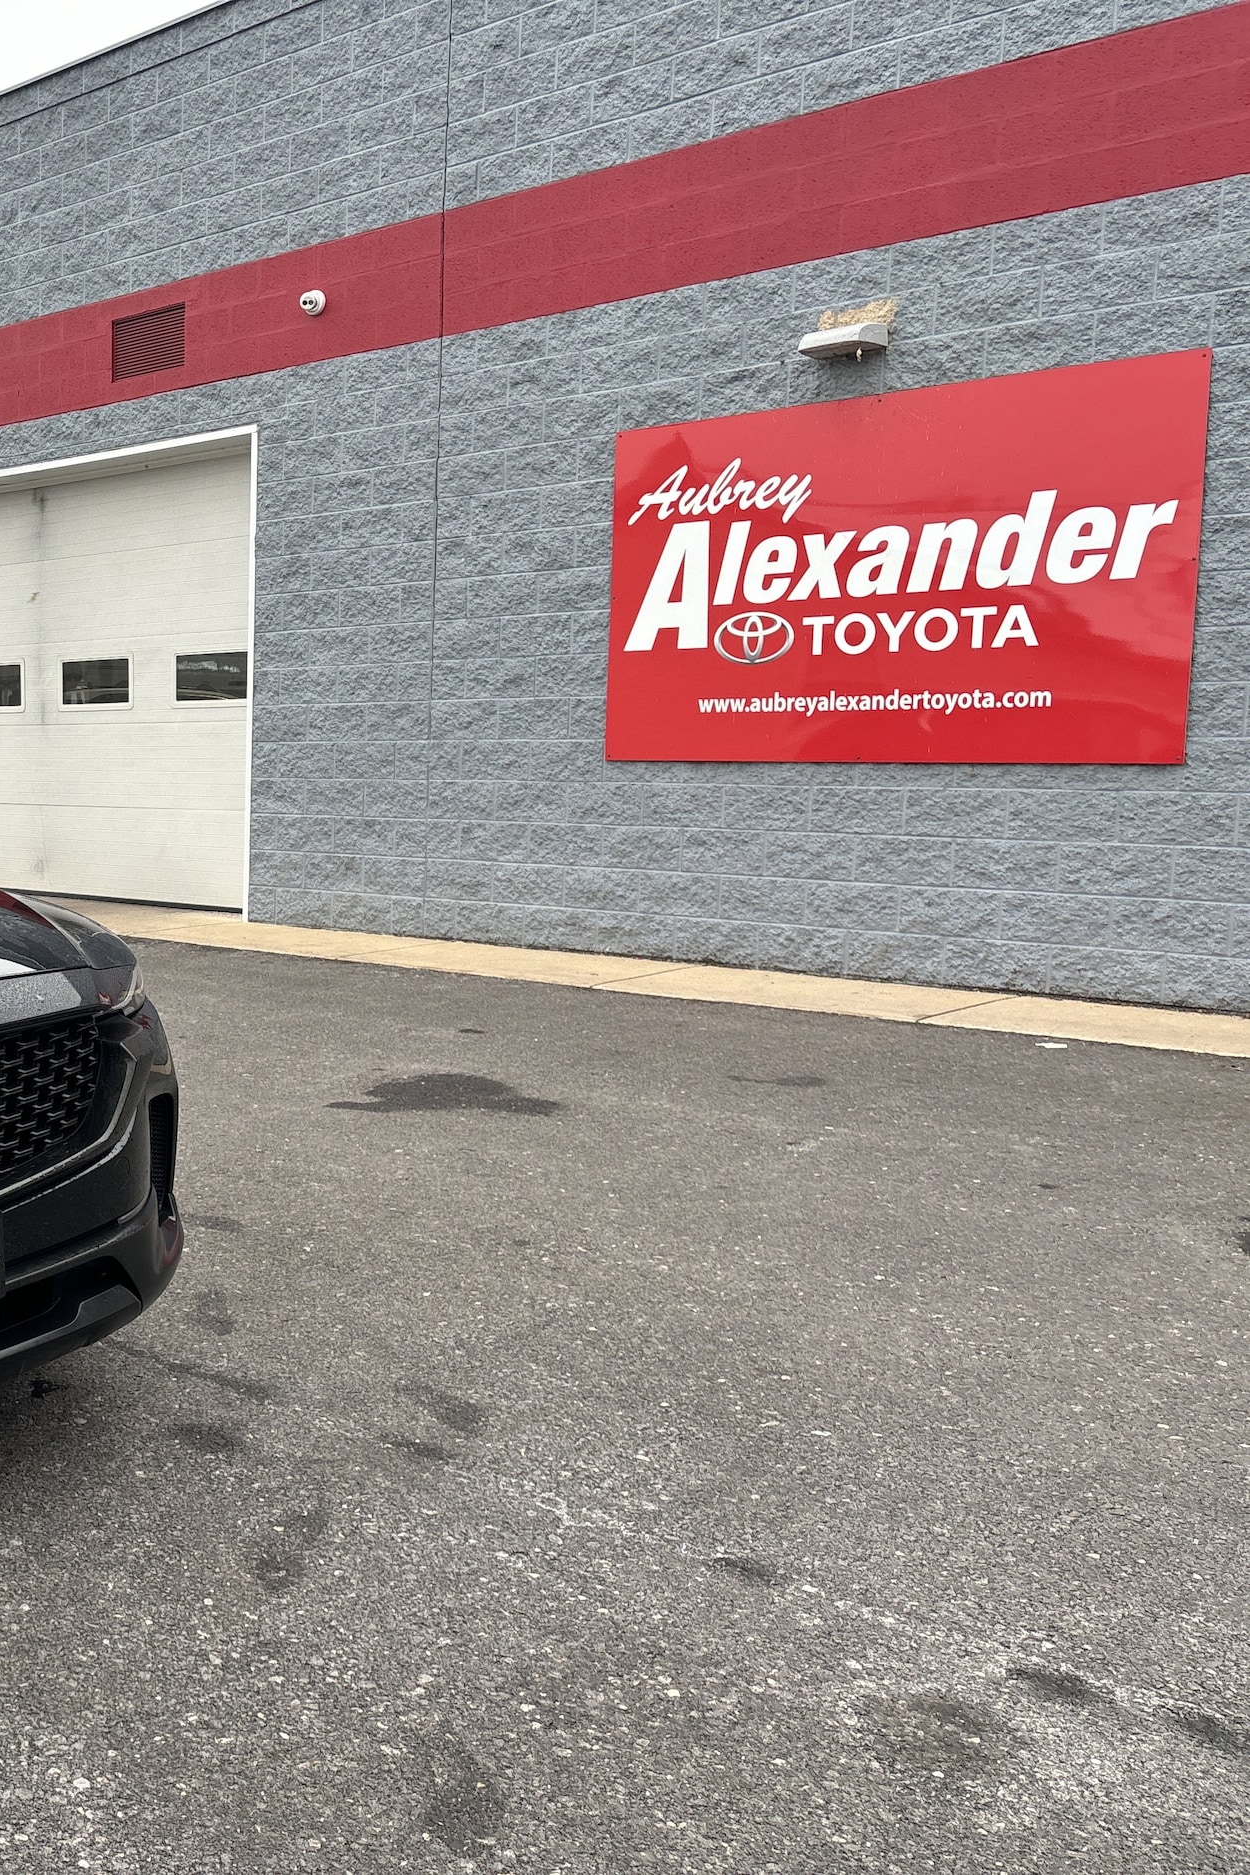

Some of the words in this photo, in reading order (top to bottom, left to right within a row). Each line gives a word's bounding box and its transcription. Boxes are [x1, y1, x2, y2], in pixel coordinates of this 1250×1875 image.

[628, 457, 812, 524] Aubrey
[623, 489, 1179, 652] Alexander
[803, 604, 1039, 656] TOYOTA
[698, 689, 1052, 717] www.aubreyalexandertoyota.com
